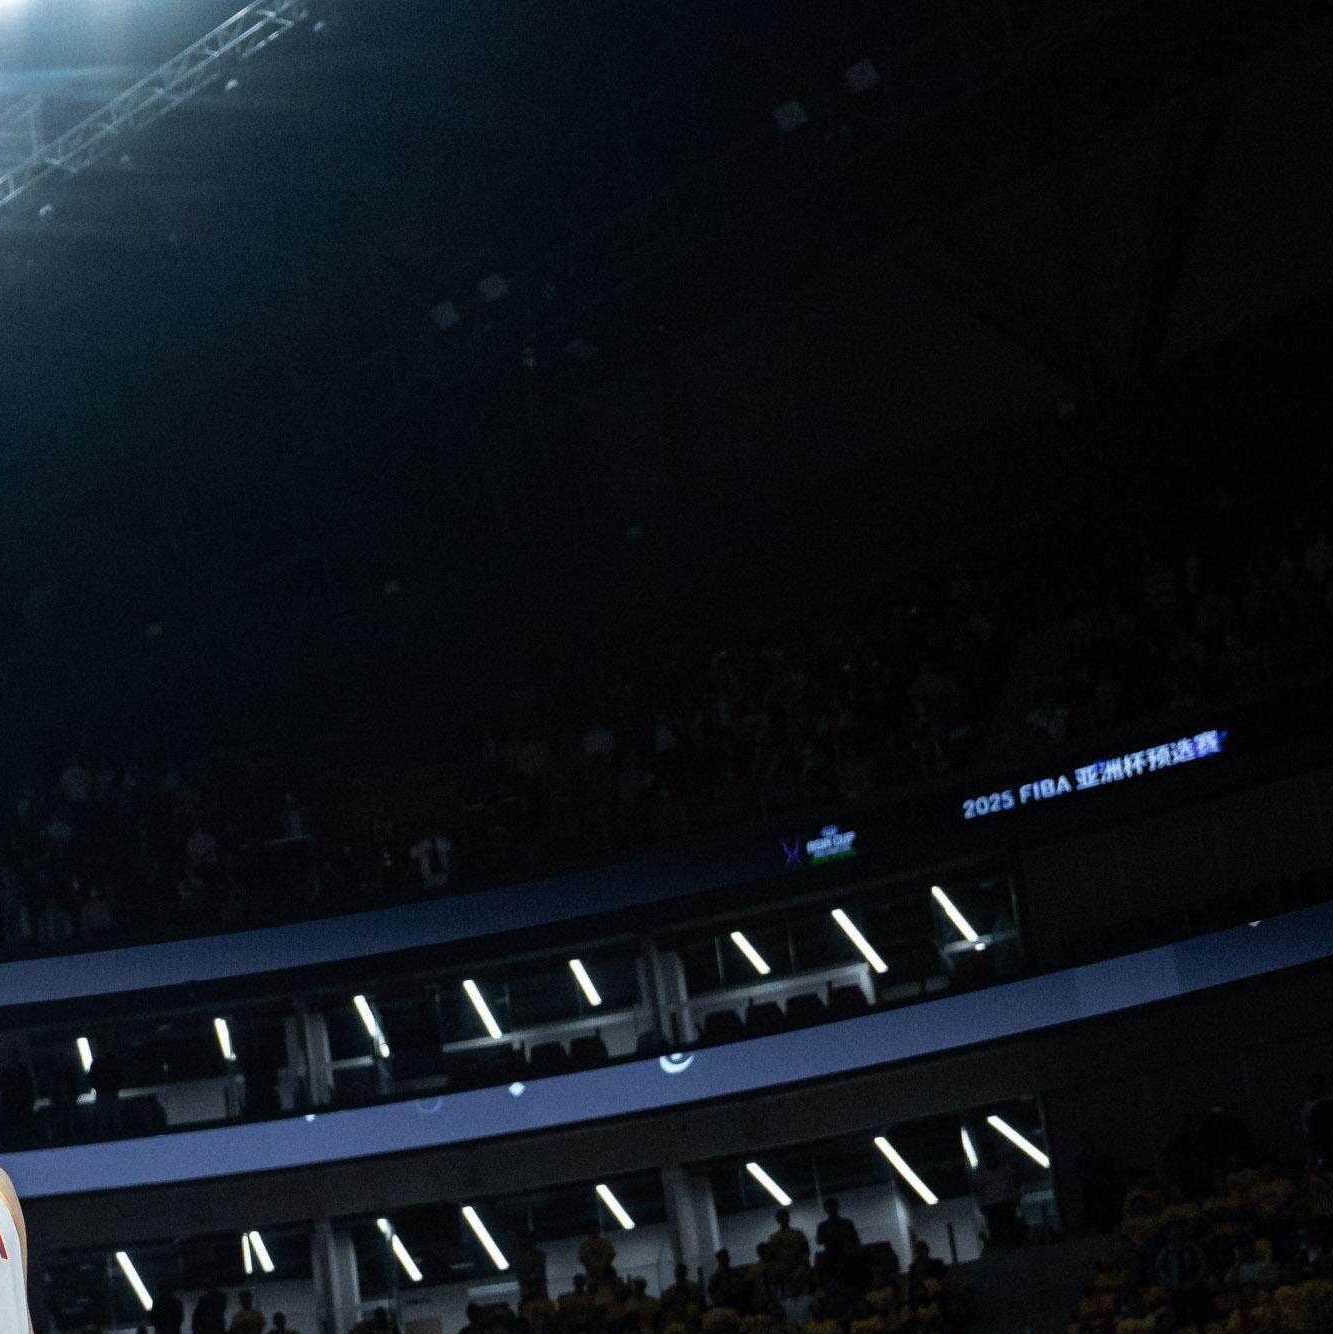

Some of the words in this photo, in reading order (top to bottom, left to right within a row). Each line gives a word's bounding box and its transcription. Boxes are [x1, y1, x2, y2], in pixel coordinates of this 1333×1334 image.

[963, 790, 1015, 819] 2025
[1019, 775, 1071, 804] FIBA
[1075, 730, 1222, 791] 亚洲杯预选赛
